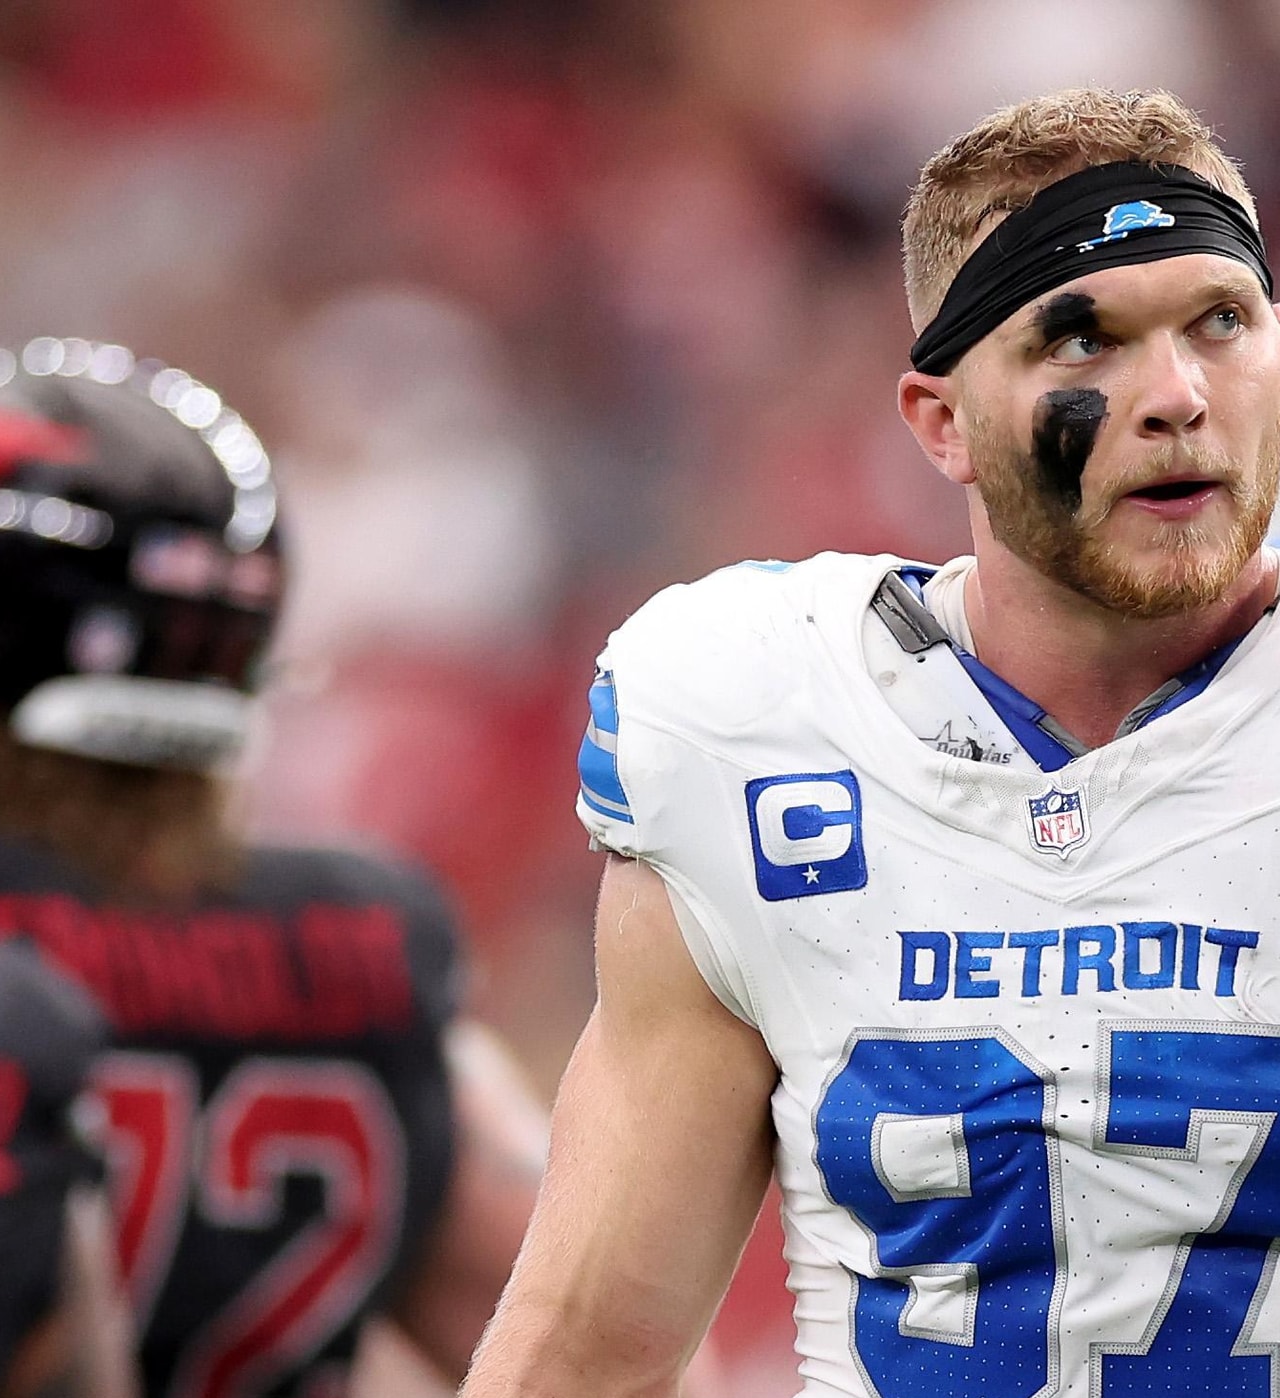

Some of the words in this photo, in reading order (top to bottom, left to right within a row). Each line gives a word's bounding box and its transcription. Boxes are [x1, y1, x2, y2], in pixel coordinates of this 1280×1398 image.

[755, 780, 852, 867] C
[1037, 812, 1081, 844] NFL
[896, 921, 1260, 1002] DETROIT
